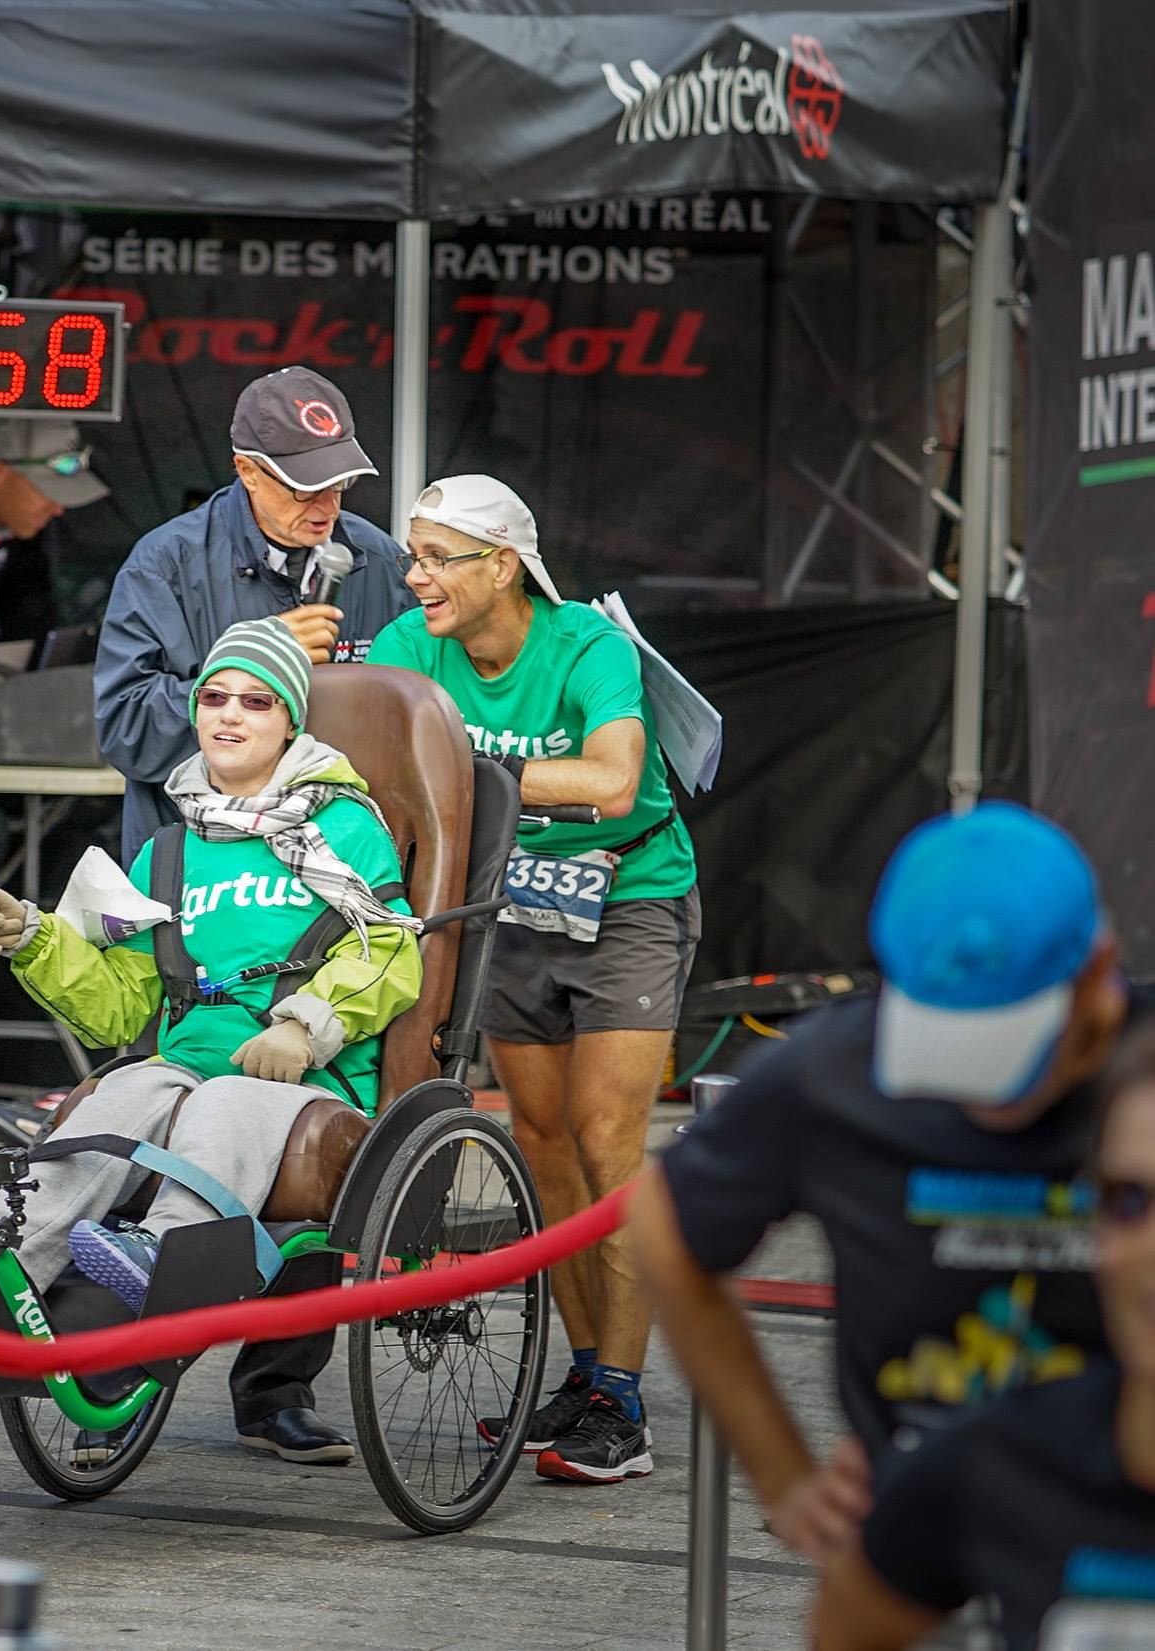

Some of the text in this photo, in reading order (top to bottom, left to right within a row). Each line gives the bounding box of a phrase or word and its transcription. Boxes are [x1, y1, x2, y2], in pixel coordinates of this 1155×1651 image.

[600, 41, 791, 145] Montréal
[83, 229, 223, 275] SÉRIE
[239, 239, 337, 277] DES
[454, 294, 708, 377] Roll
[460, 713, 573, 761] artus
[181, 872, 314, 936] artus
[507, 860, 606, 903] 3532
